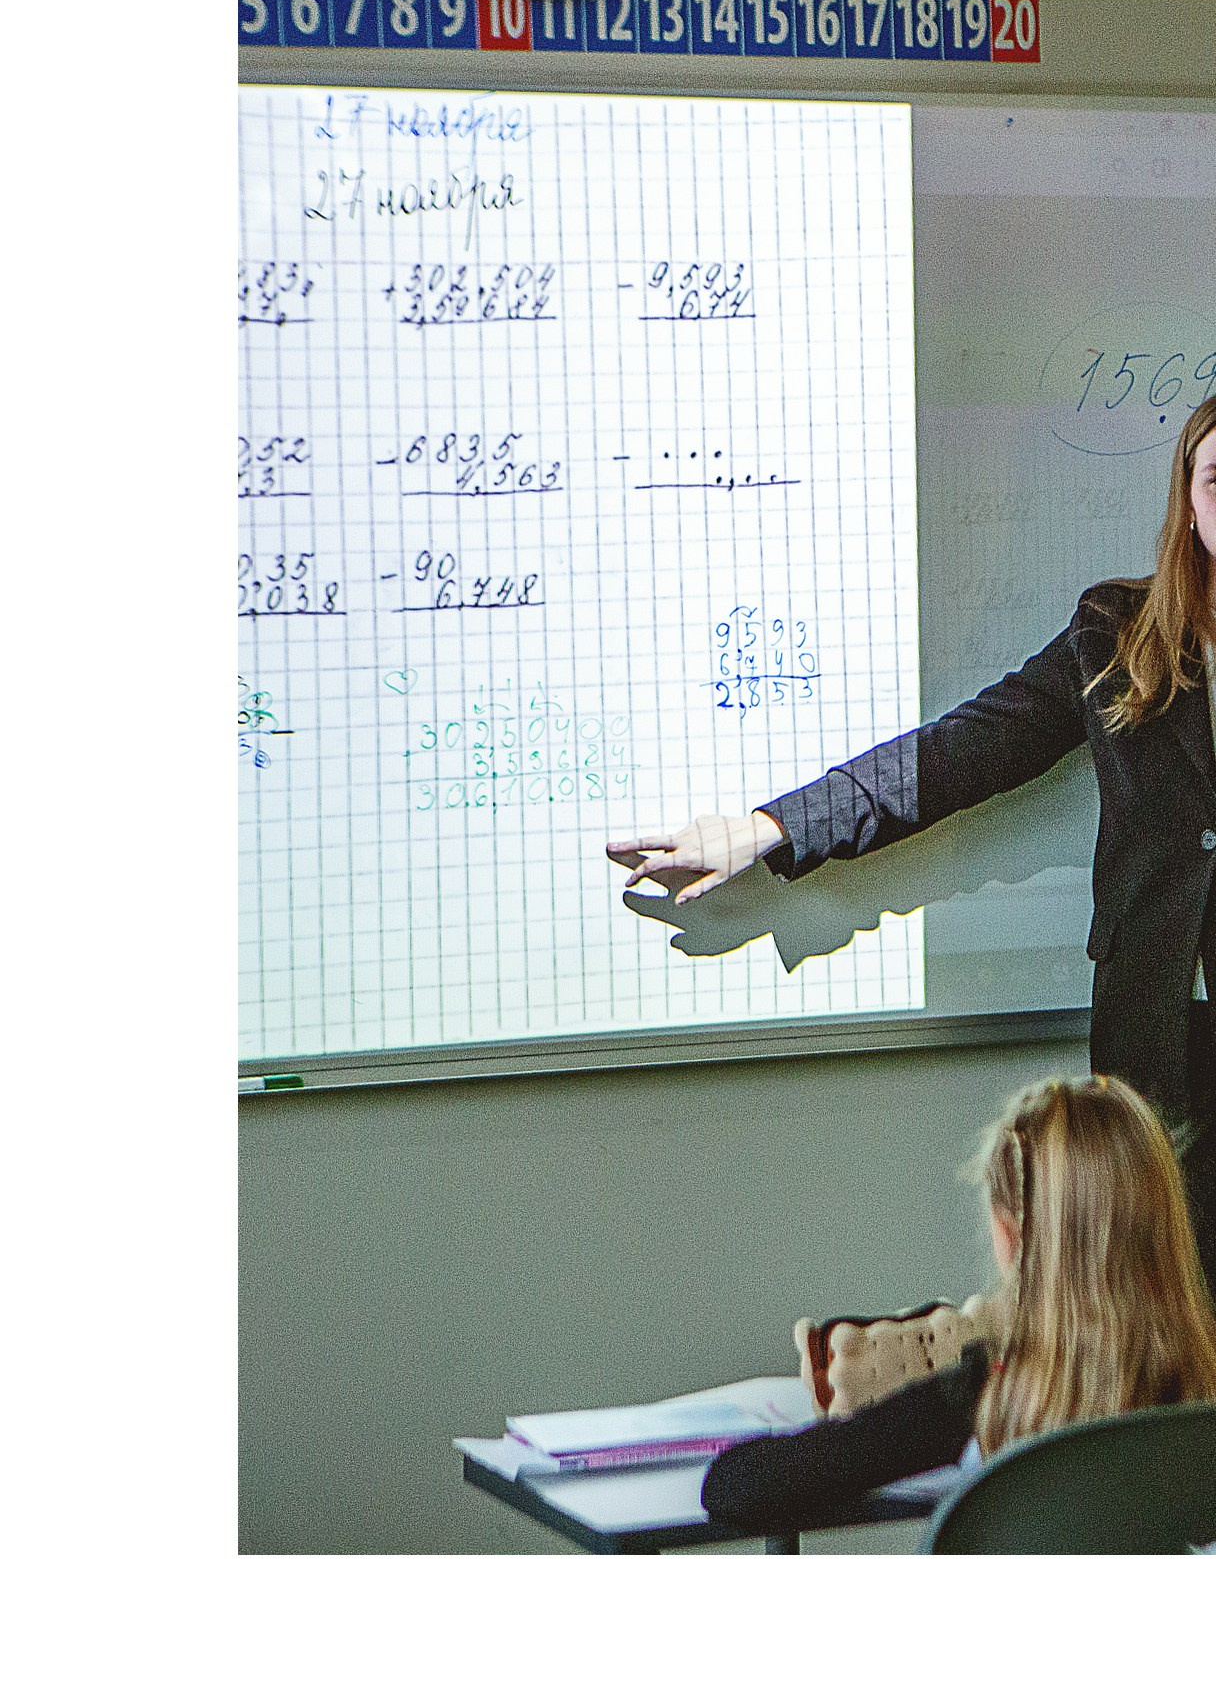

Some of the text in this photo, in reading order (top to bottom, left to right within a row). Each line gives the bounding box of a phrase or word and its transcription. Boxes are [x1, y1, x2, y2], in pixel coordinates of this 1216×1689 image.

[304, 166, 524, 251] 27 ноября
[415, 550, 456, 581] 90
